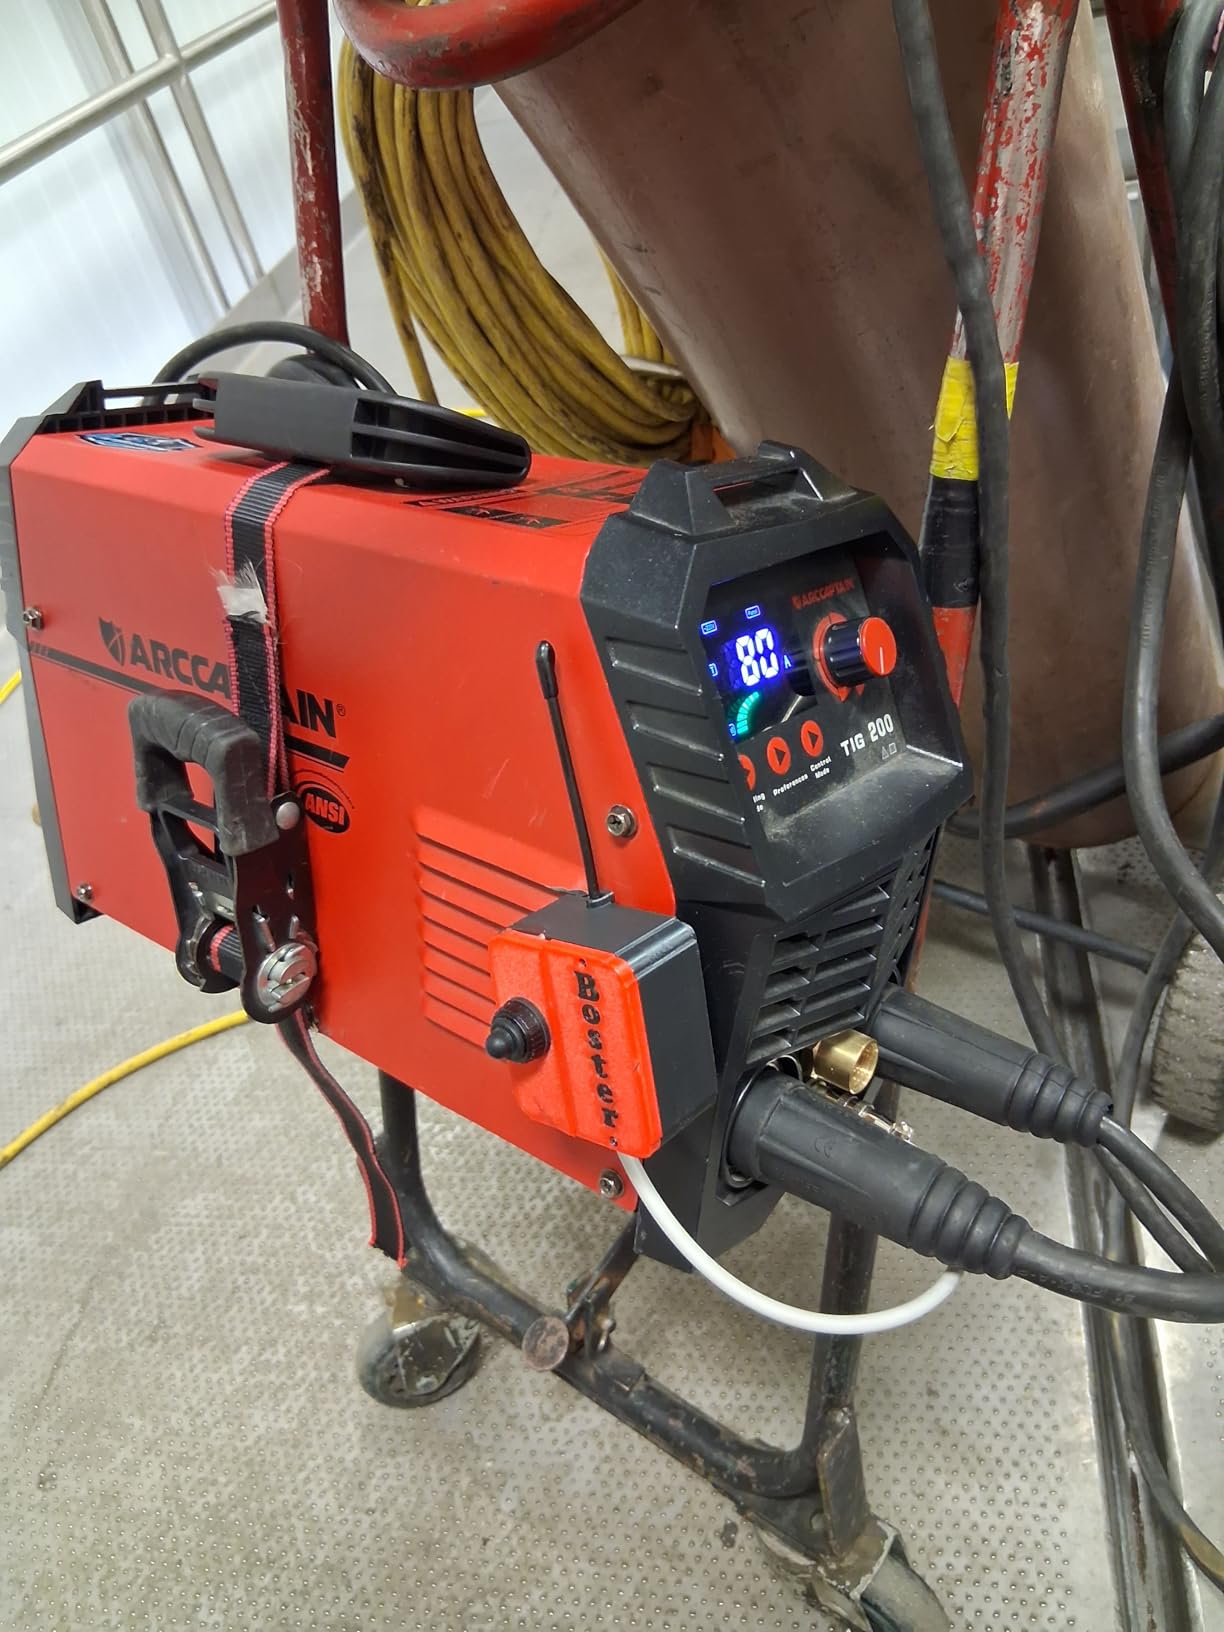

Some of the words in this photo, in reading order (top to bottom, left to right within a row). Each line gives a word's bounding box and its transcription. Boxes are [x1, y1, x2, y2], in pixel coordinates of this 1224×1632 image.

[735, 628, 779, 687] 80
[783, 654, 792, 670] A
[840, 732, 866, 757] TIG
[867, 713, 894, 744] 200
[810, 755, 832, 772] Control
[814, 767, 830, 779] Mode
[773, 773, 808, 797] Preferences
[305, 793, 345, 826] ANSI
[574, 970, 619, 1129] Boster
